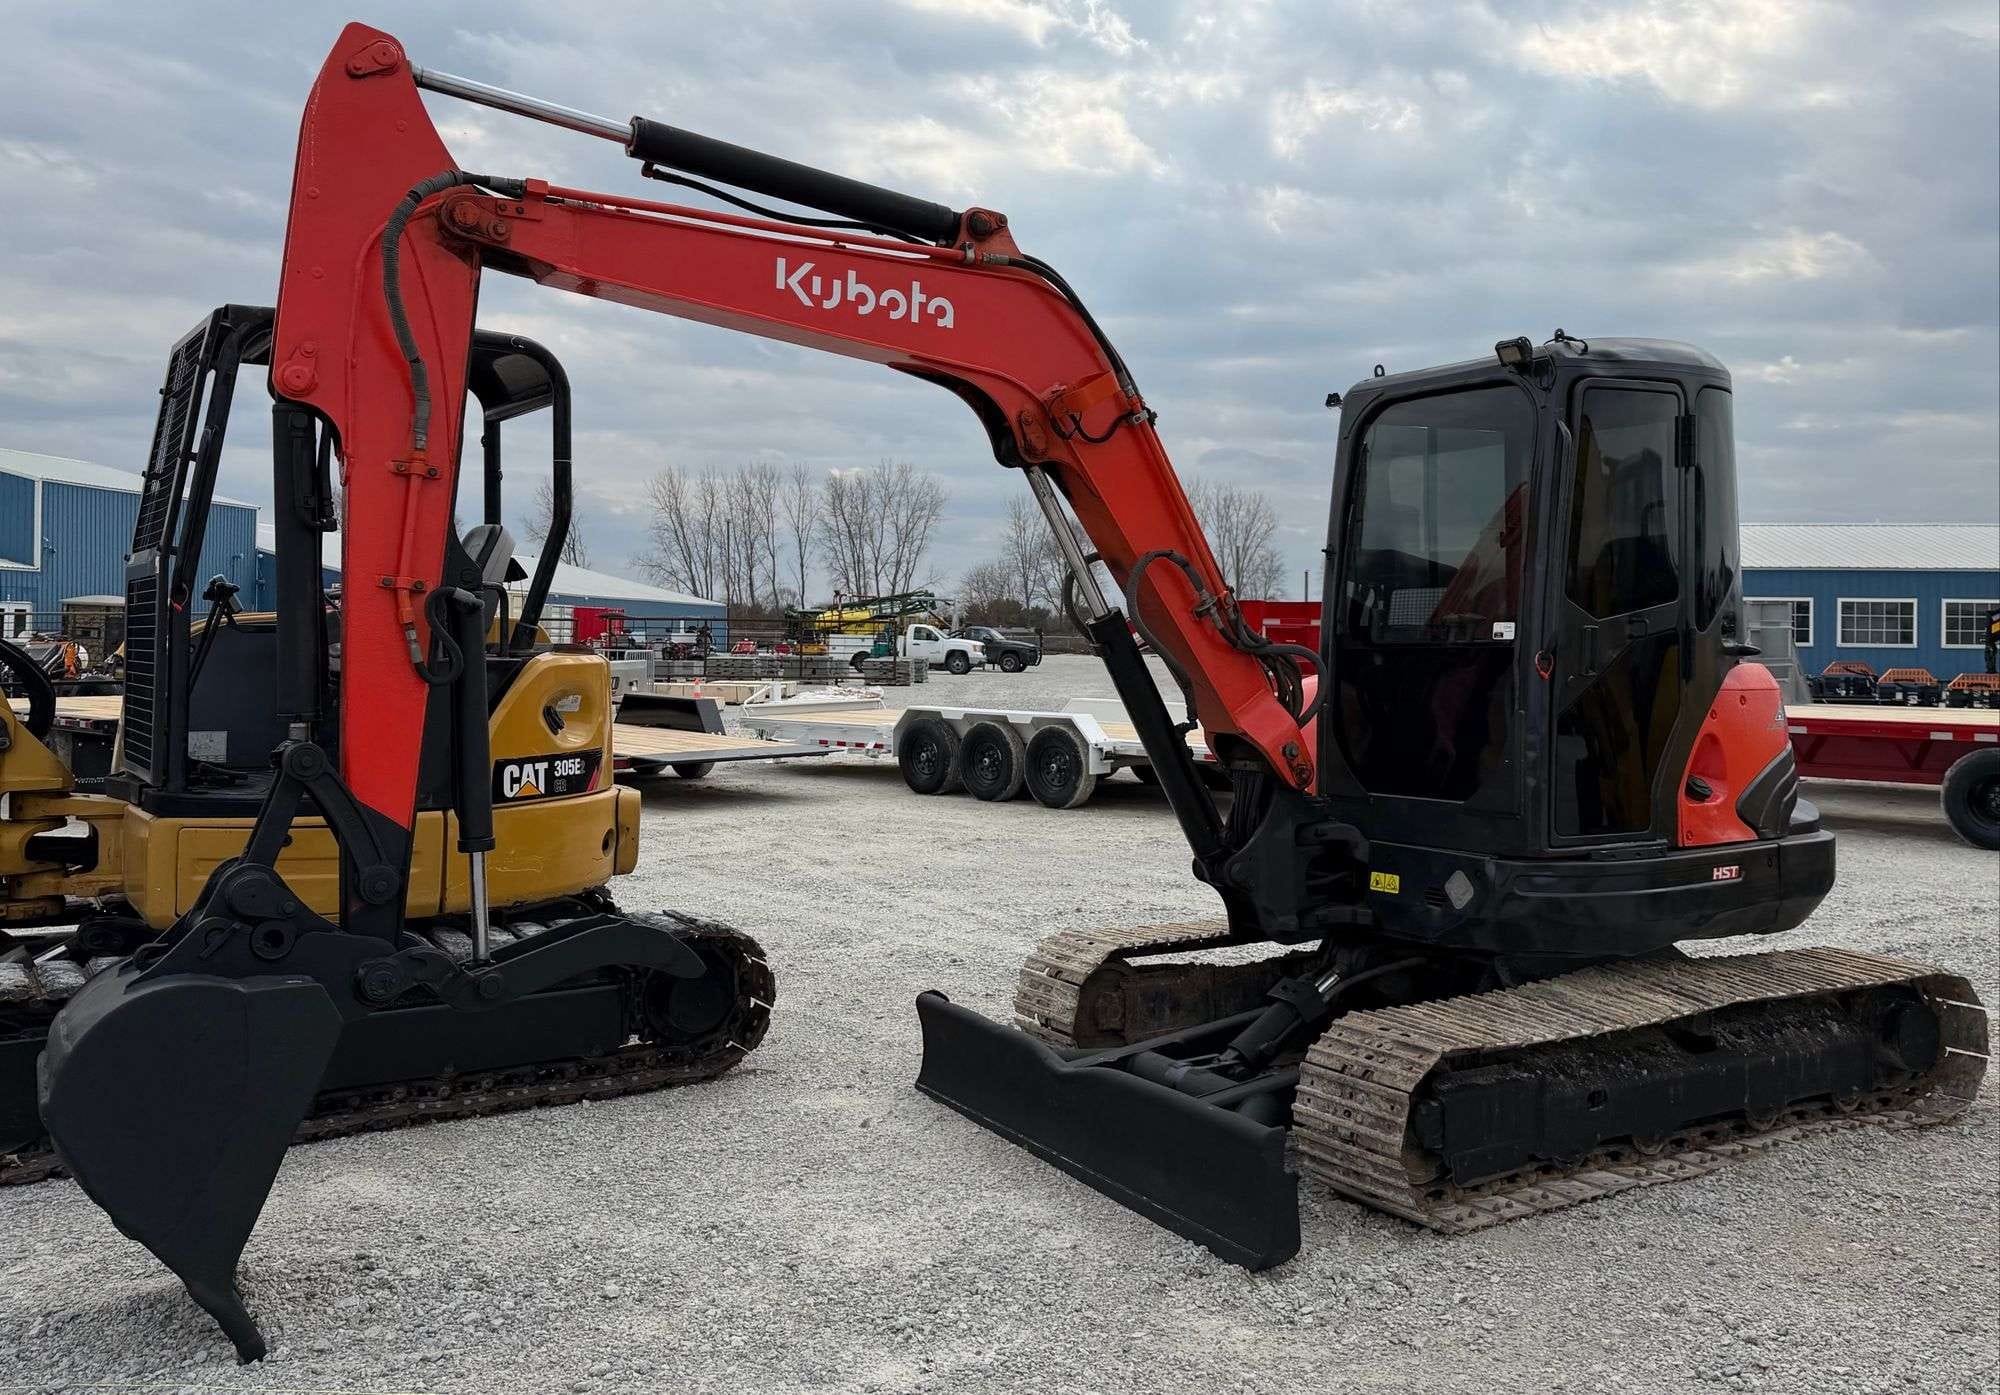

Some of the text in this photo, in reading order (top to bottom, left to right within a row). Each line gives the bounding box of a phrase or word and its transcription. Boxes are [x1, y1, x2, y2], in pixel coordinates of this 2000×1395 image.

[776, 257, 954, 328] Kubota
[503, 762, 548, 798] CAT
[1713, 865, 1739, 880] HST
